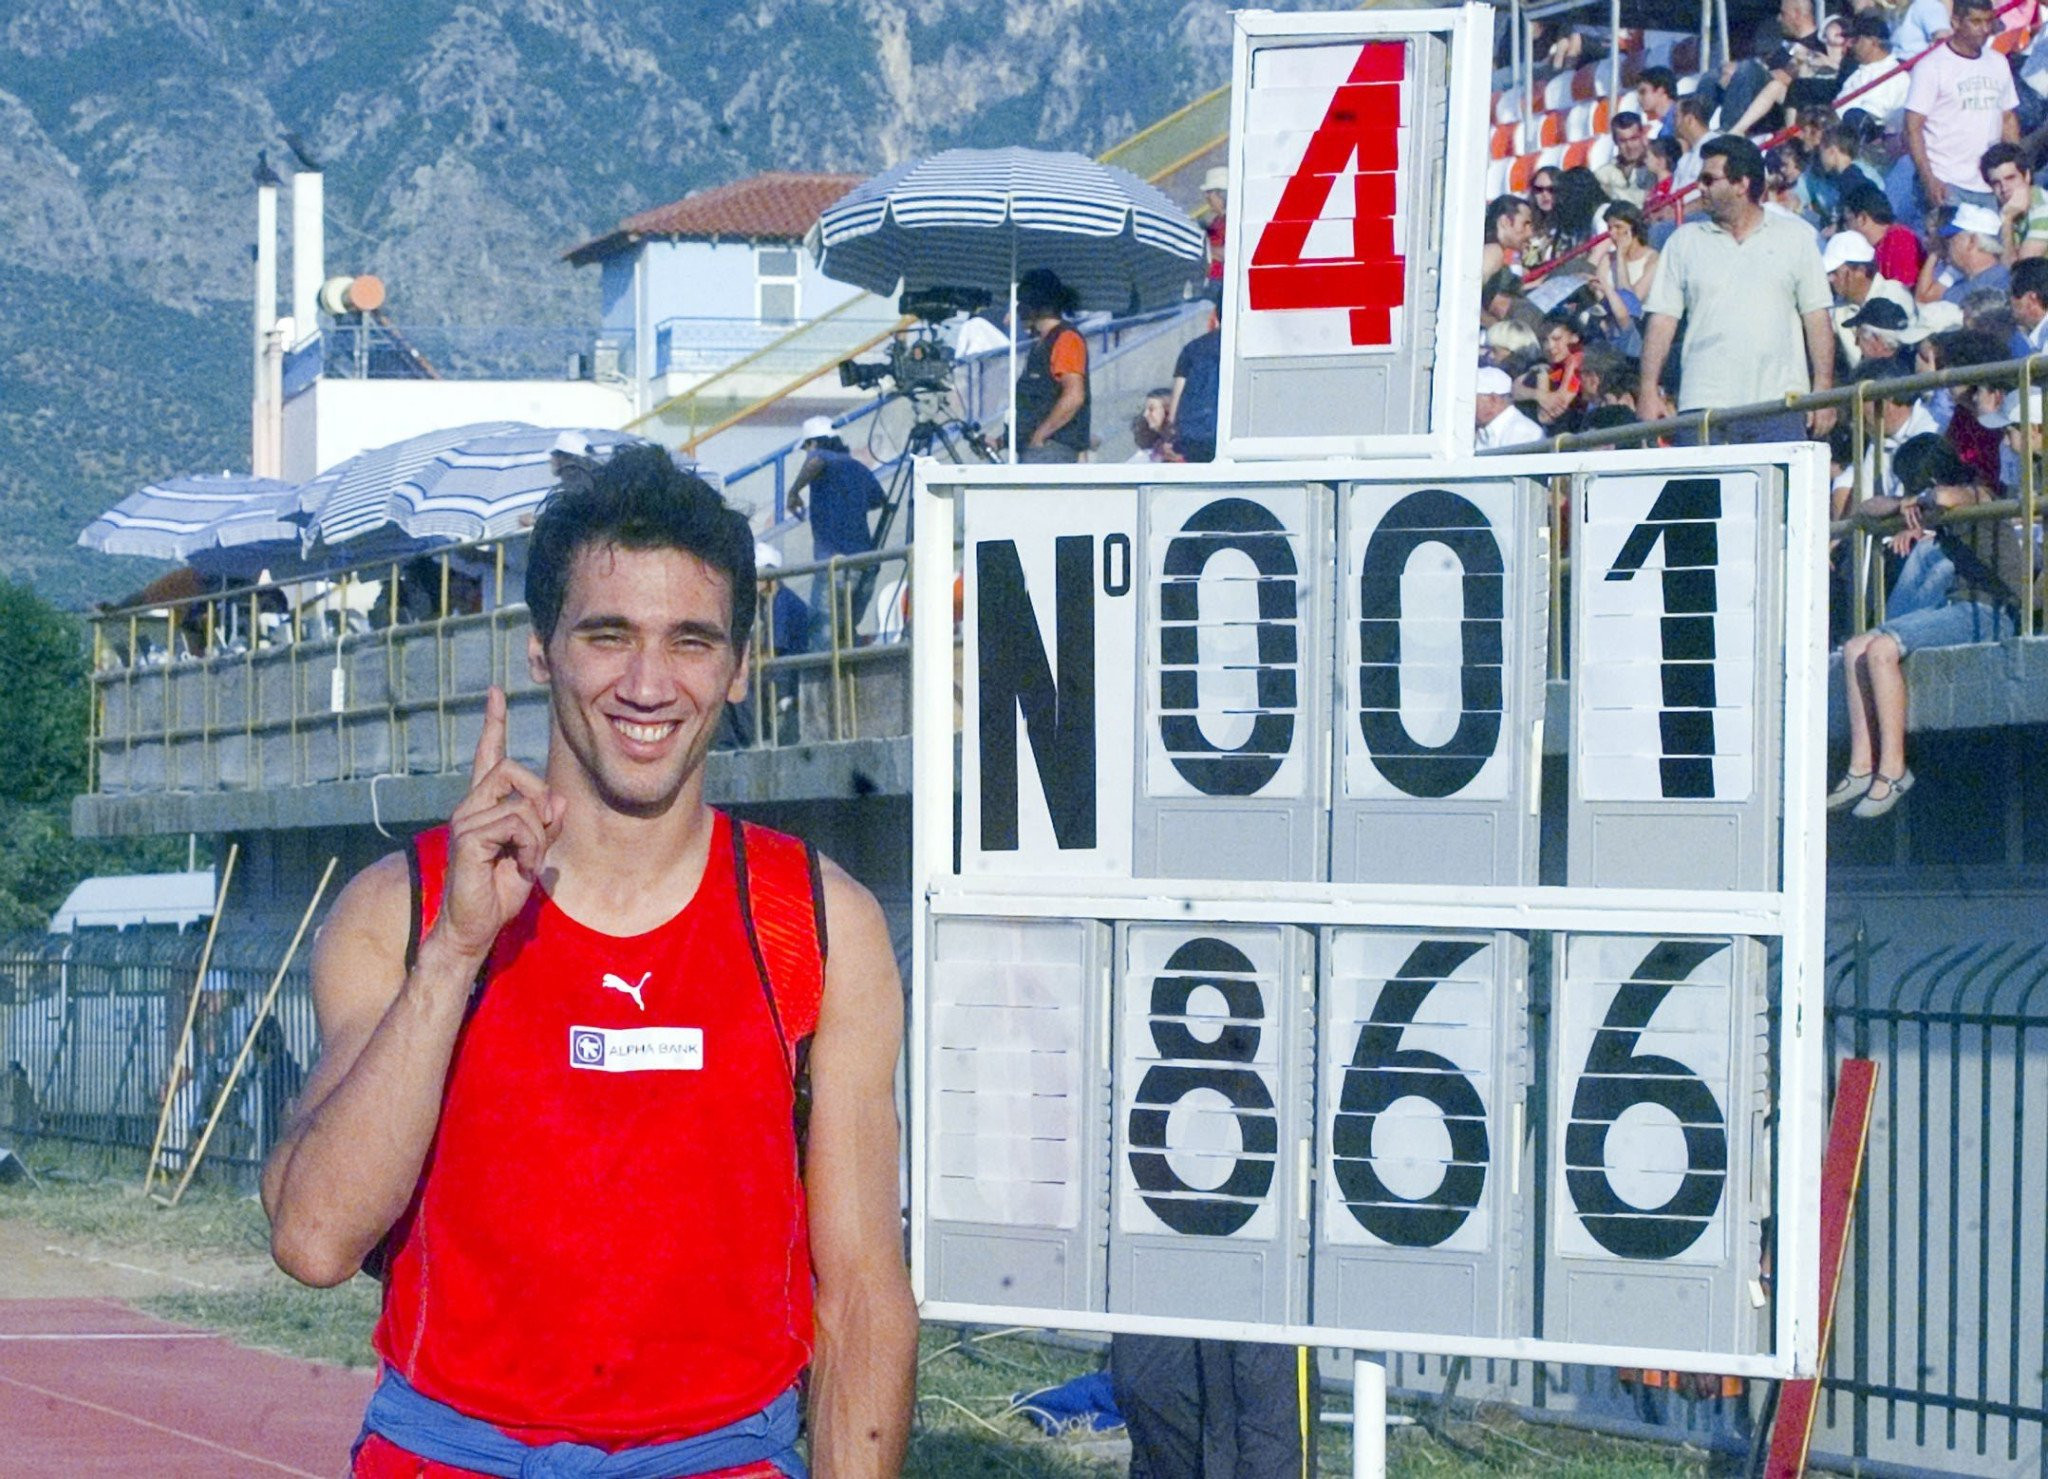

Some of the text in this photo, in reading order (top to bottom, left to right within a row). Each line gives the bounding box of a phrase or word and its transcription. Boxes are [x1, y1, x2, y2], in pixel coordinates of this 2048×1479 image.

[1248, 41, 1406, 347] 4
[609, 1043, 698, 1057] ALPHA BANK
